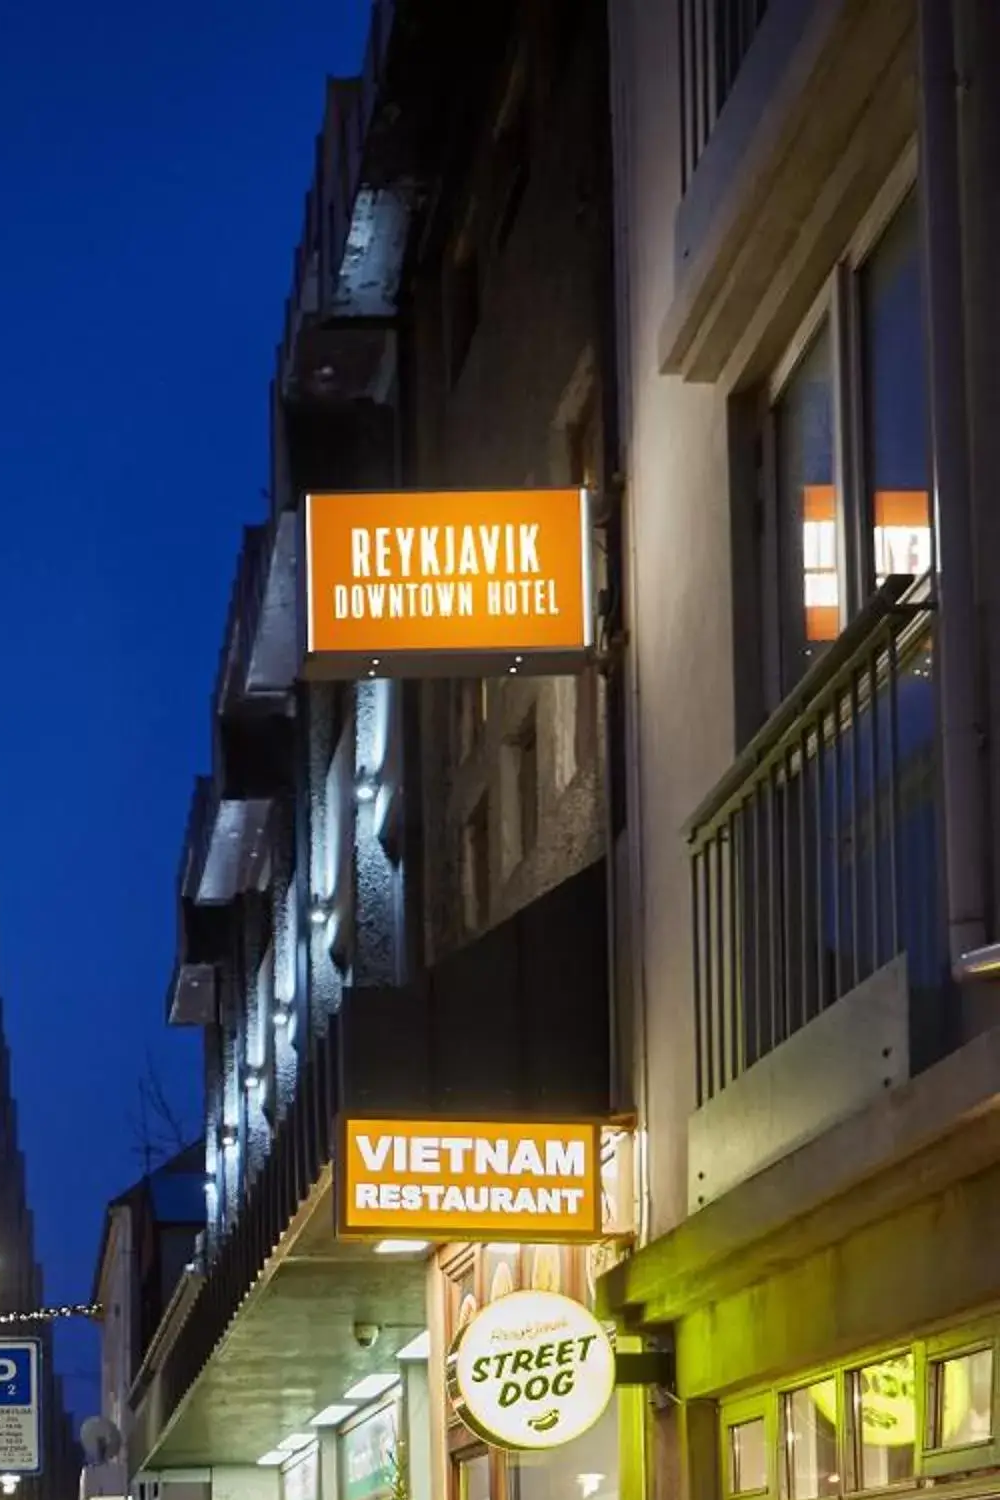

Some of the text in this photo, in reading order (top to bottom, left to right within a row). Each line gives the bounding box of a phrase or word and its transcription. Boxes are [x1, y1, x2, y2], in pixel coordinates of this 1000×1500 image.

[351, 524, 540, 577] REYKJAVIK
[334, 579, 560, 619] DOWNTOWN HOTEL
[355, 1135, 584, 1176] VIETNAM
[355, 1183, 585, 1215] RESTAURANT
[472, 1333, 597, 1383] STREET
[497, 1370, 576, 1409] DOG
